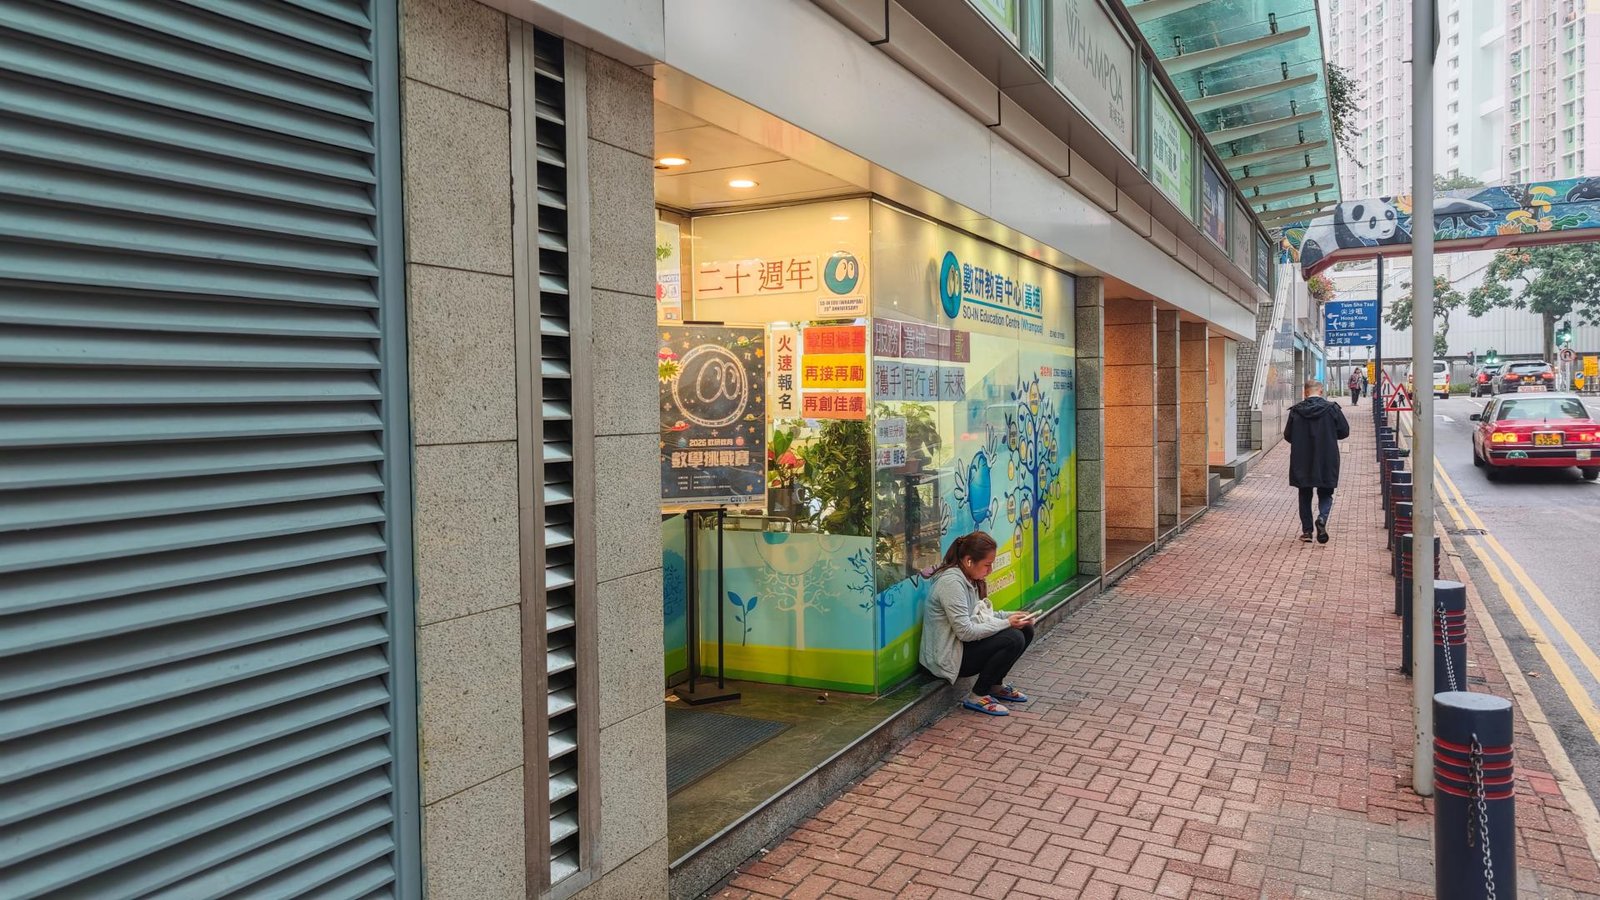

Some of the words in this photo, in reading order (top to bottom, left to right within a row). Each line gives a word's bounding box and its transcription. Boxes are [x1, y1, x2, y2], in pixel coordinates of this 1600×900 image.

[1065, 4, 1124, 111] WHAMPOA
[698, 257, 814, 294] 二十週年
[963, 305, 980, 320] SO-IN
[980, 309, 1005, 326] Education
[1006, 314, 1020, 329] Centre
[777, 335, 792, 410] 火速報名
[805, 365, 864, 382] 再接再勵
[803, 396, 864, 412] 再創佳績
[689, 438, 707, 447] 2025
[671, 450, 750, 469] 數學挑戰賽
